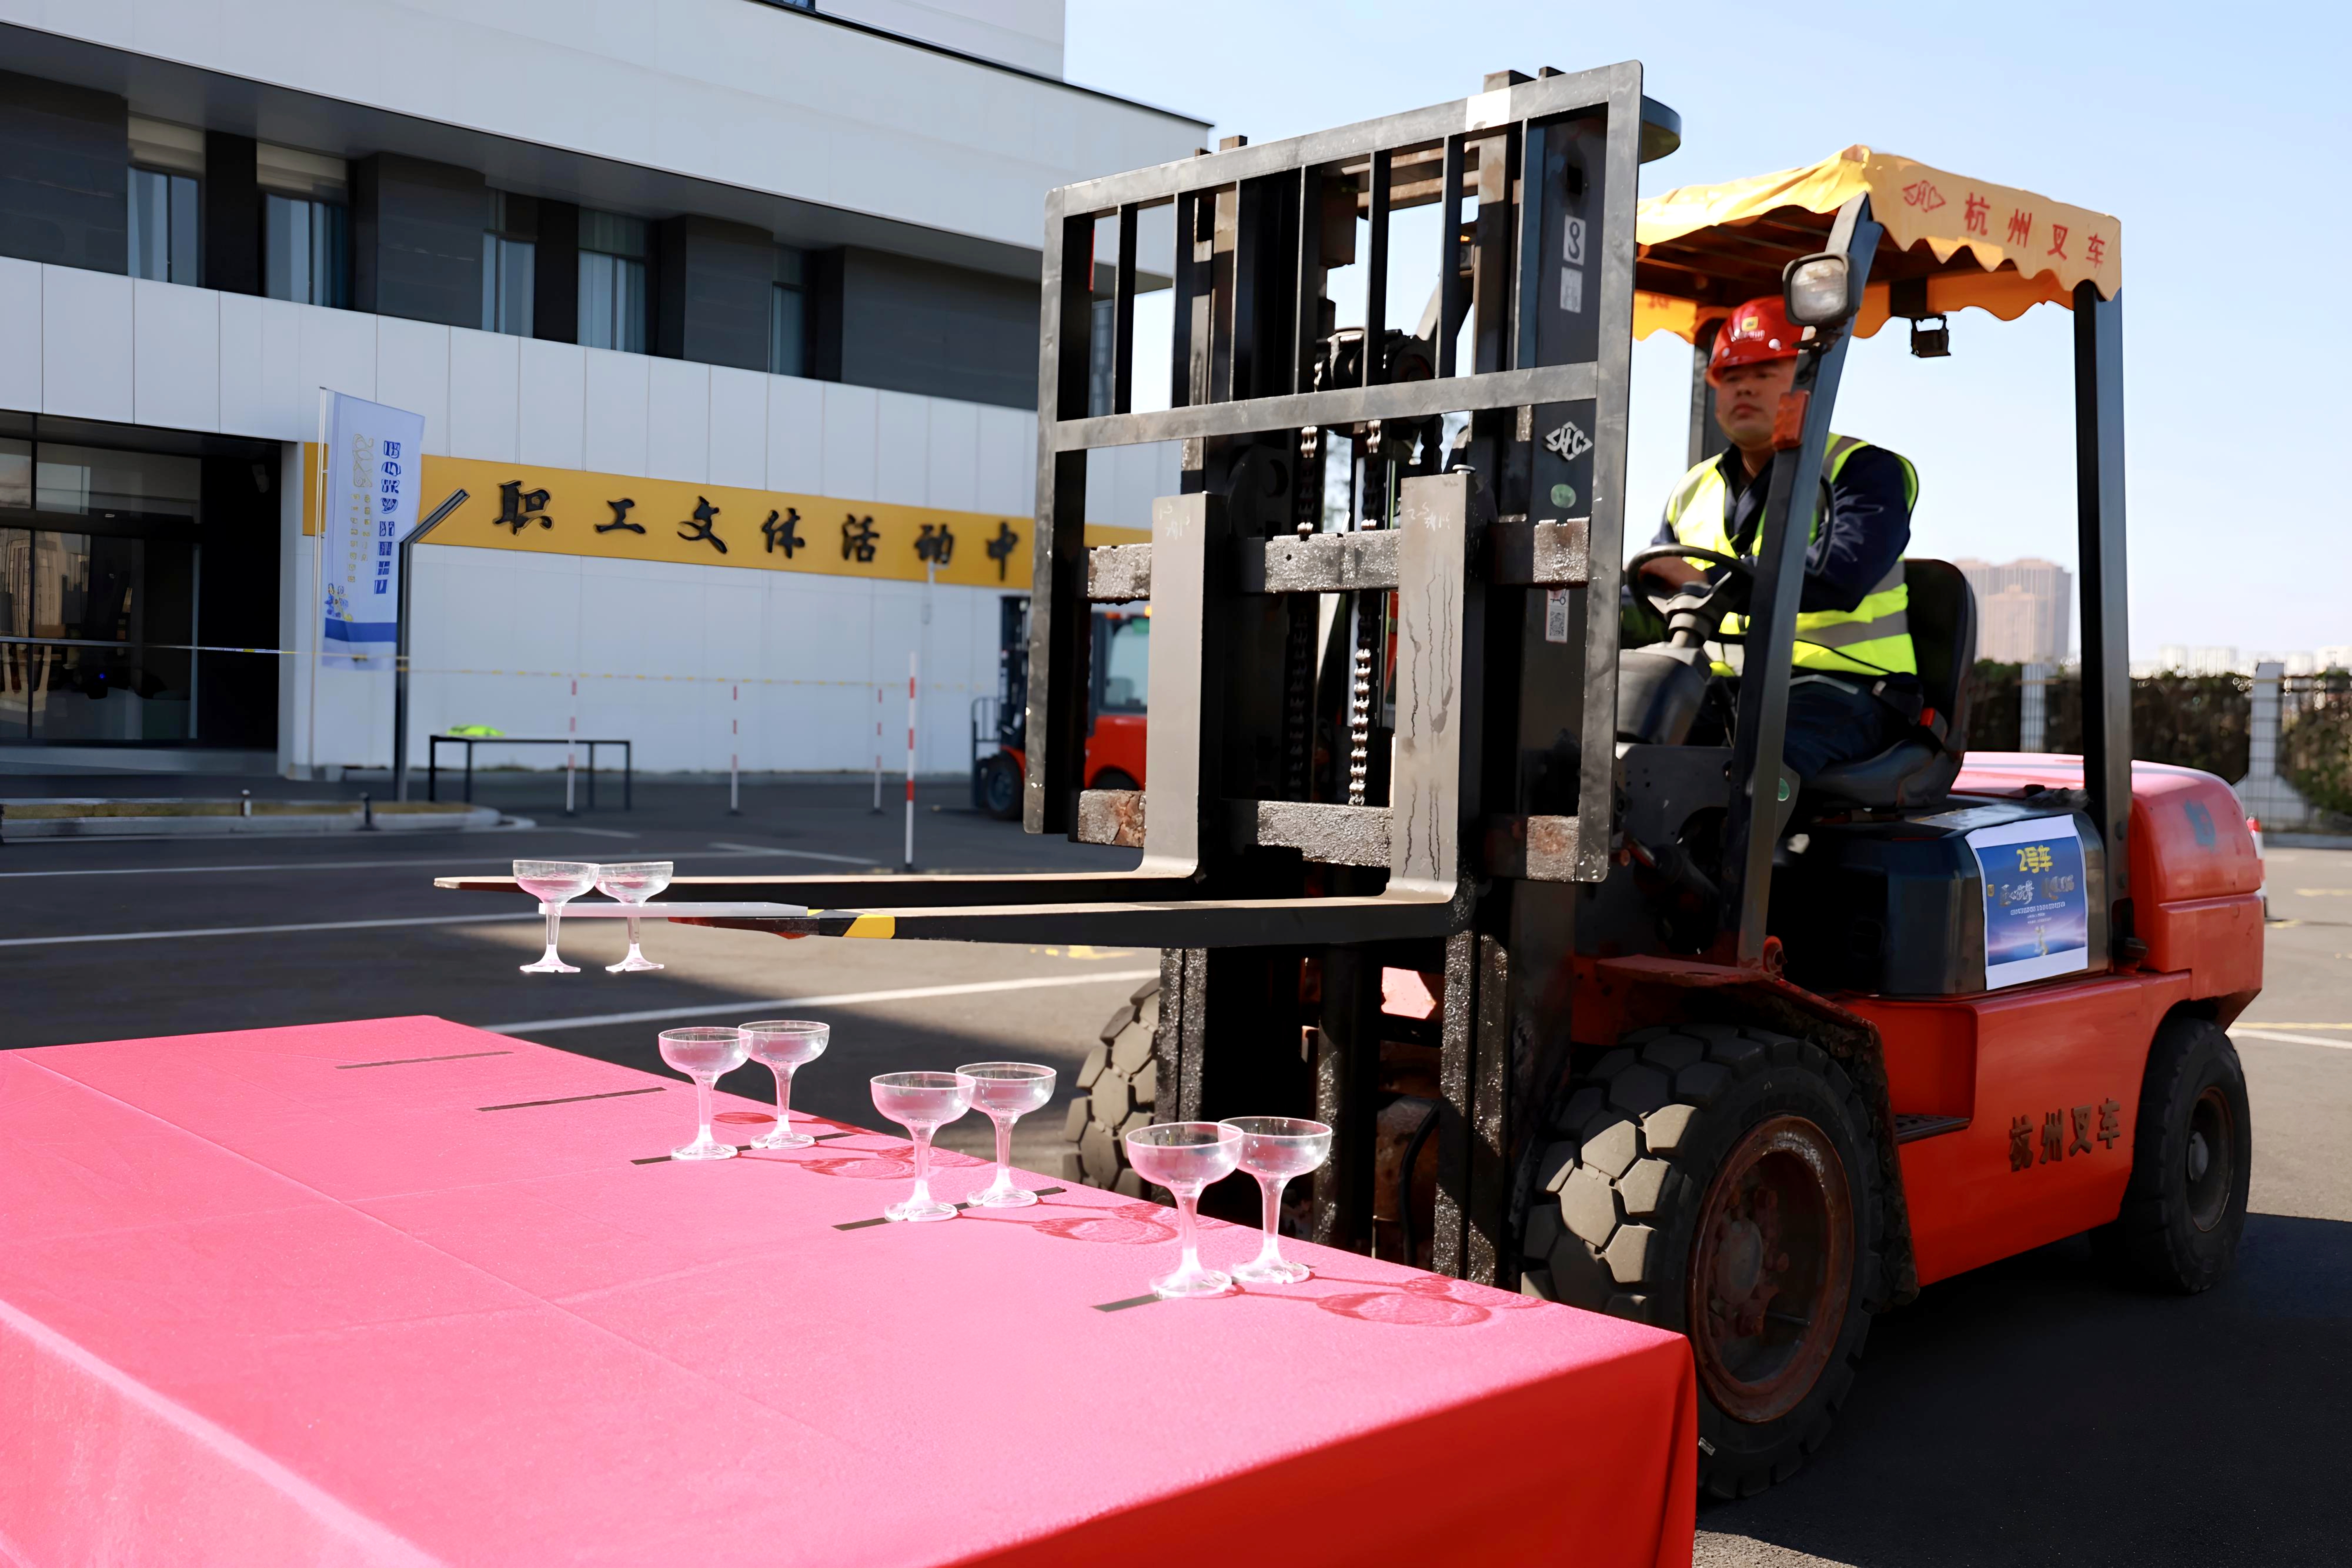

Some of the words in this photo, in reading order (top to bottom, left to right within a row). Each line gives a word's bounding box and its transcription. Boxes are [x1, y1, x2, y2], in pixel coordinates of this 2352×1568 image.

[1964, 192, 2105, 268] 杭州叉车
[492, 480, 1020, 582] 职工文体活动中
[2009, 1098, 2120, 1172] 杭州叉车
